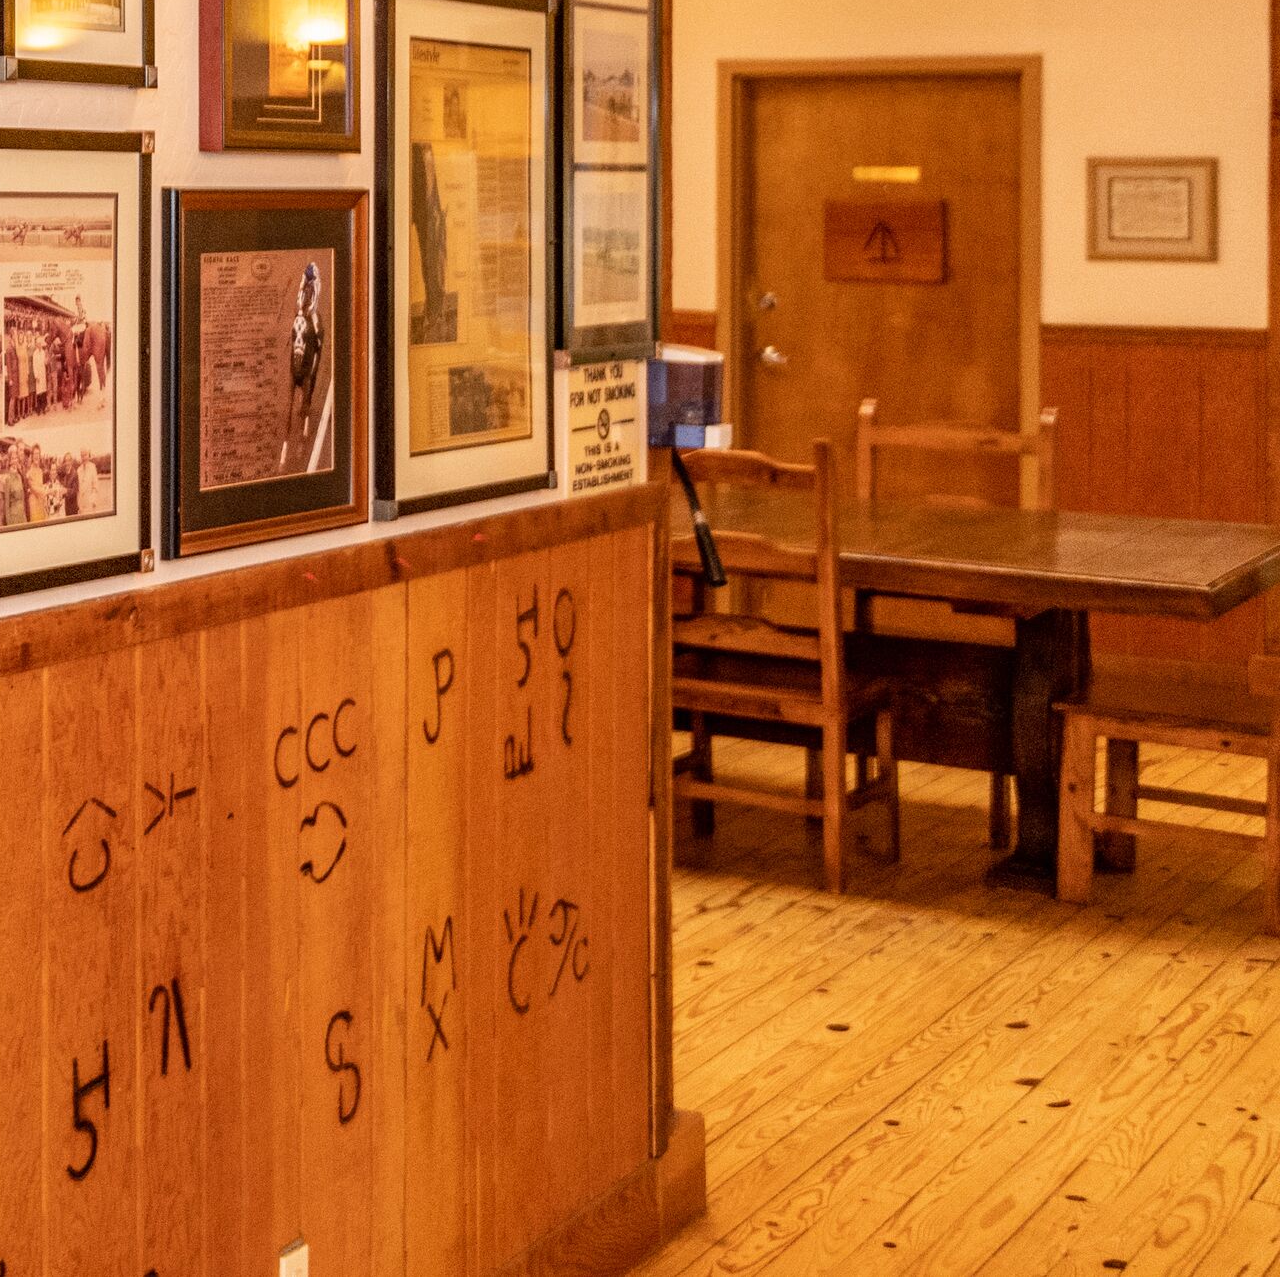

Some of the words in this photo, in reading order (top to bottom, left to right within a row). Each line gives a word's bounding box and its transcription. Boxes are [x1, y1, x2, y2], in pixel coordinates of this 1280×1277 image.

[583, 366, 607, 383] THANK
[609, 363, 624, 380] YOU
[569, 390, 585, 408] FOR
[587, 388, 601, 405] NOT
[604, 383, 636, 402] SMOKING
[584, 445, 601, 457] THIS
[575, 454, 631, 476] NON-SMOKING
[572, 470, 634, 492] ESTABLISHMENT
[272, 699, 359, 789] CCC
